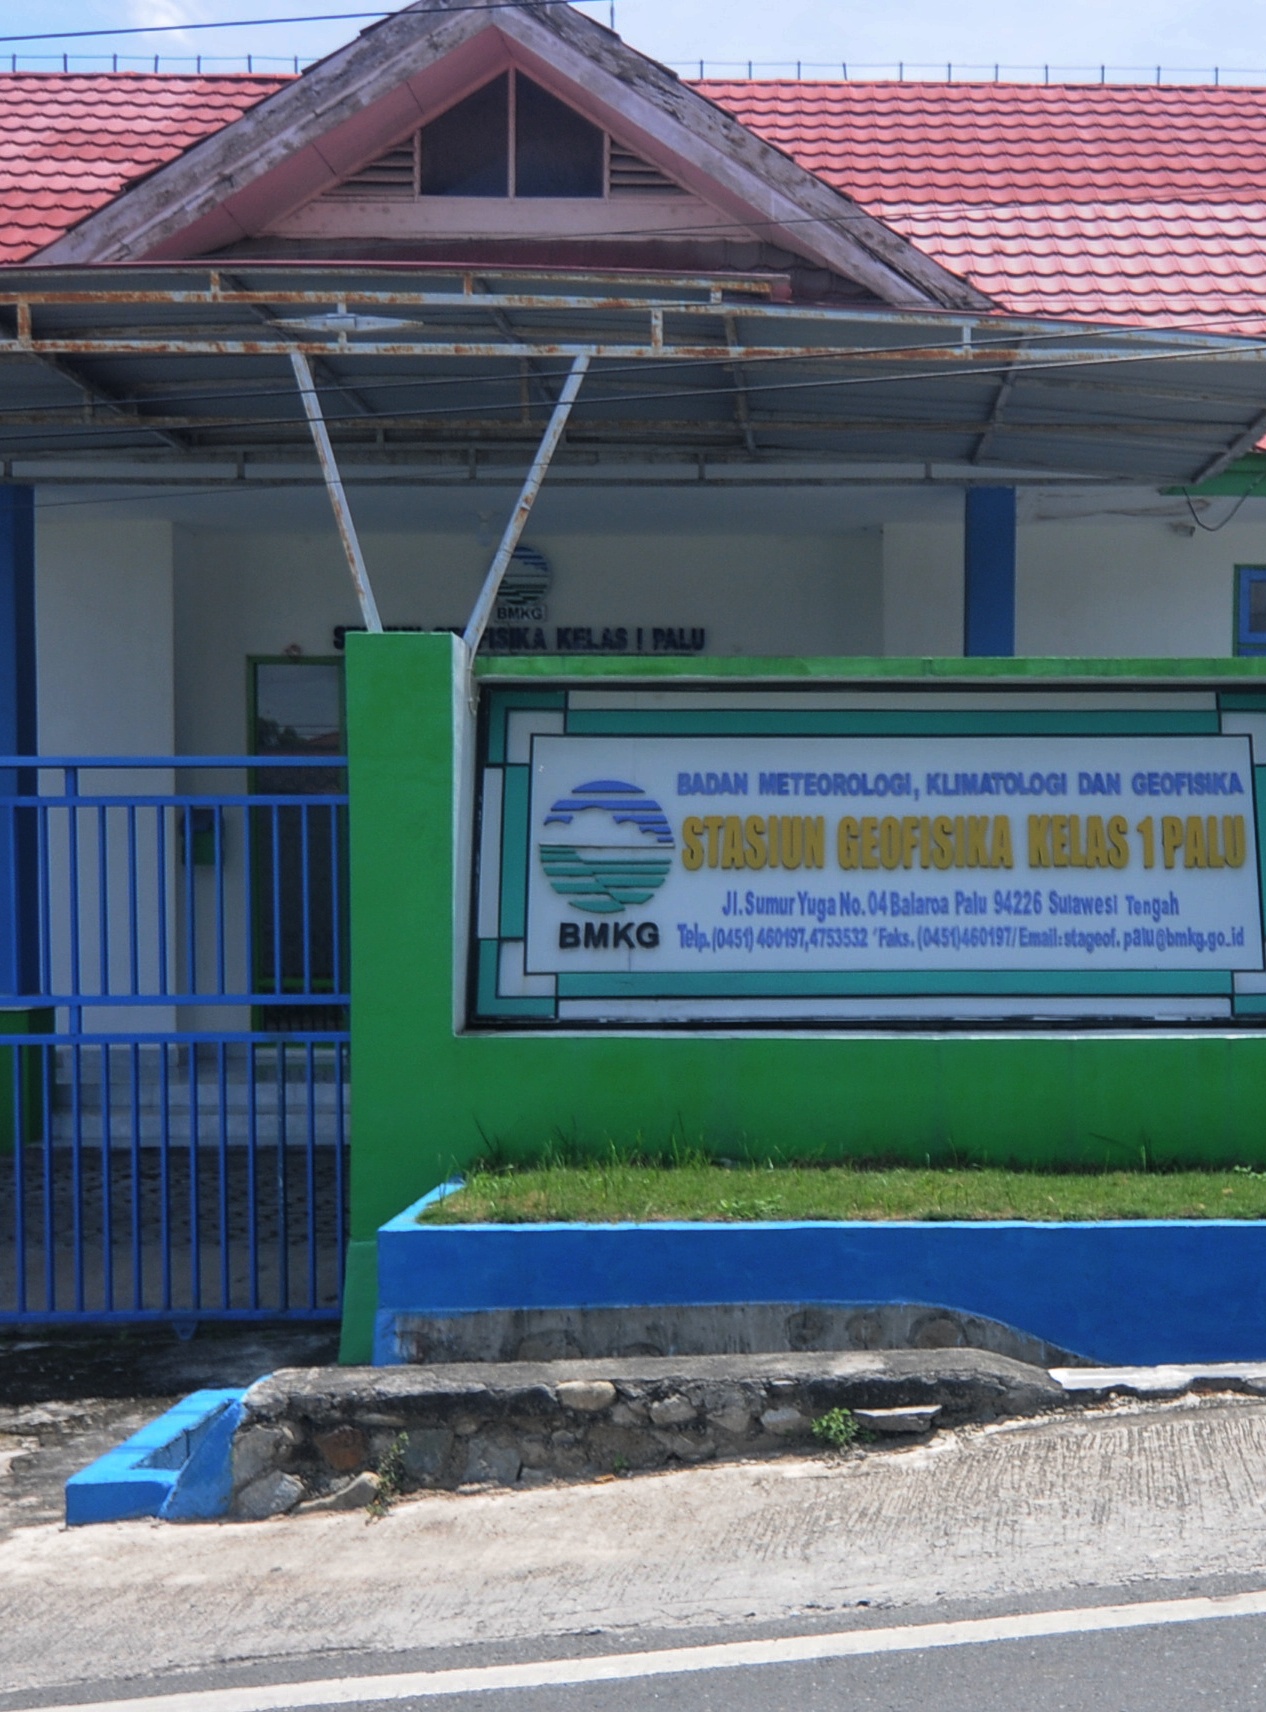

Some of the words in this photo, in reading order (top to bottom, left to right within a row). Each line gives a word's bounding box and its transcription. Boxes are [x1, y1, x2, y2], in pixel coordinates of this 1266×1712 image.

[497, 606, 543, 621] BMKG
[556, 627, 628, 650] KELAS
[652, 627, 706, 651] PALU
[677, 772, 748, 796] BADAN
[758, 772, 919, 801] METEOROLOGI,
[926, 773, 1067, 797] KLIMATOLOGI
[1078, 773, 1121, 796] DAN
[1132, 772, 1244, 797] GEOFISIKA
[681, 815, 825, 870] STASIUN
[837, 815, 1013, 870] GEOFISIKA
[1027, 814, 1129, 870] KELAS
[1137, 816, 1154, 869] 1
[1162, 815, 1247, 870] PALU
[890, 891, 949, 917] Balaroa
[954, 891, 988, 916] Palu
[994, 890, 1043, 916] 94226
[1049, 891, 1118, 917] Sulawesi
[1125, 890, 1181, 923] Tengah
[559, 922, 660, 949] BMKG
